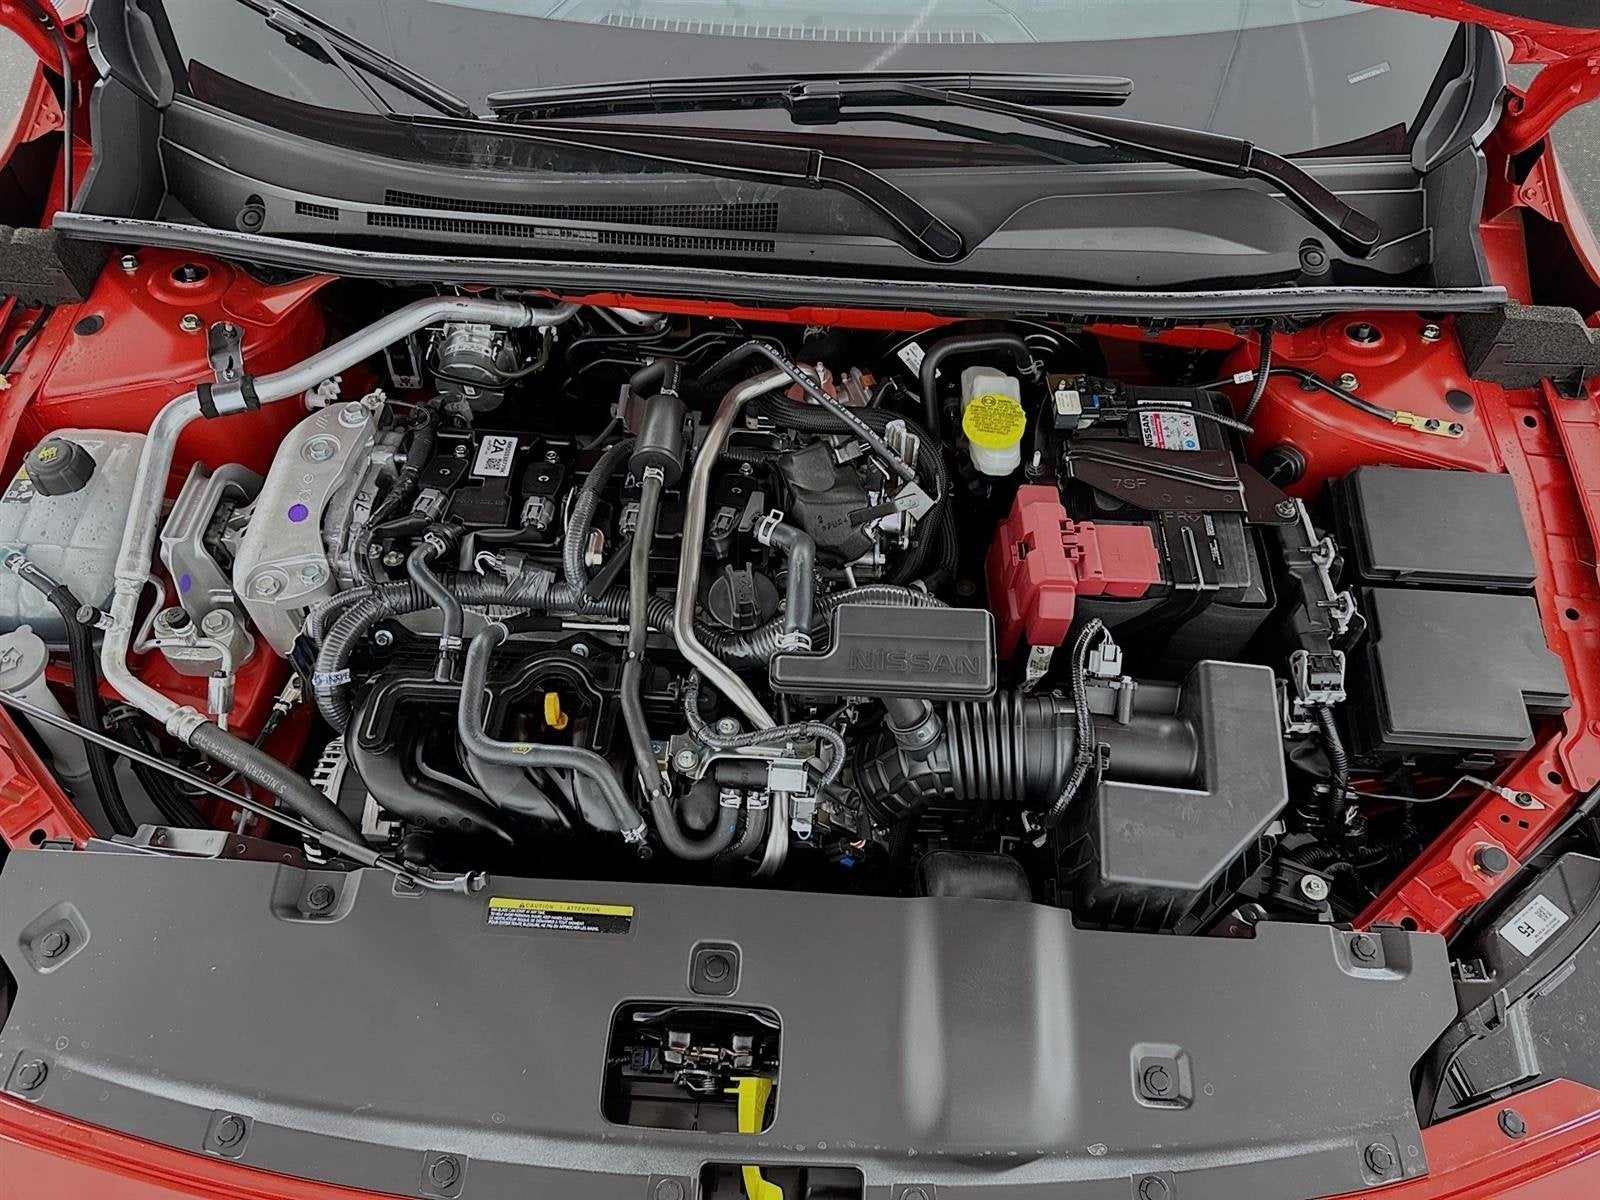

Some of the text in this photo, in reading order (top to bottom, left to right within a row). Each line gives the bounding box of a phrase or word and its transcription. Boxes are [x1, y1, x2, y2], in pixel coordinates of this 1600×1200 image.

[491, 439, 507, 454] 2A
[849, 648, 981, 675] NISSAN
[1518, 921, 1535, 937] F5
